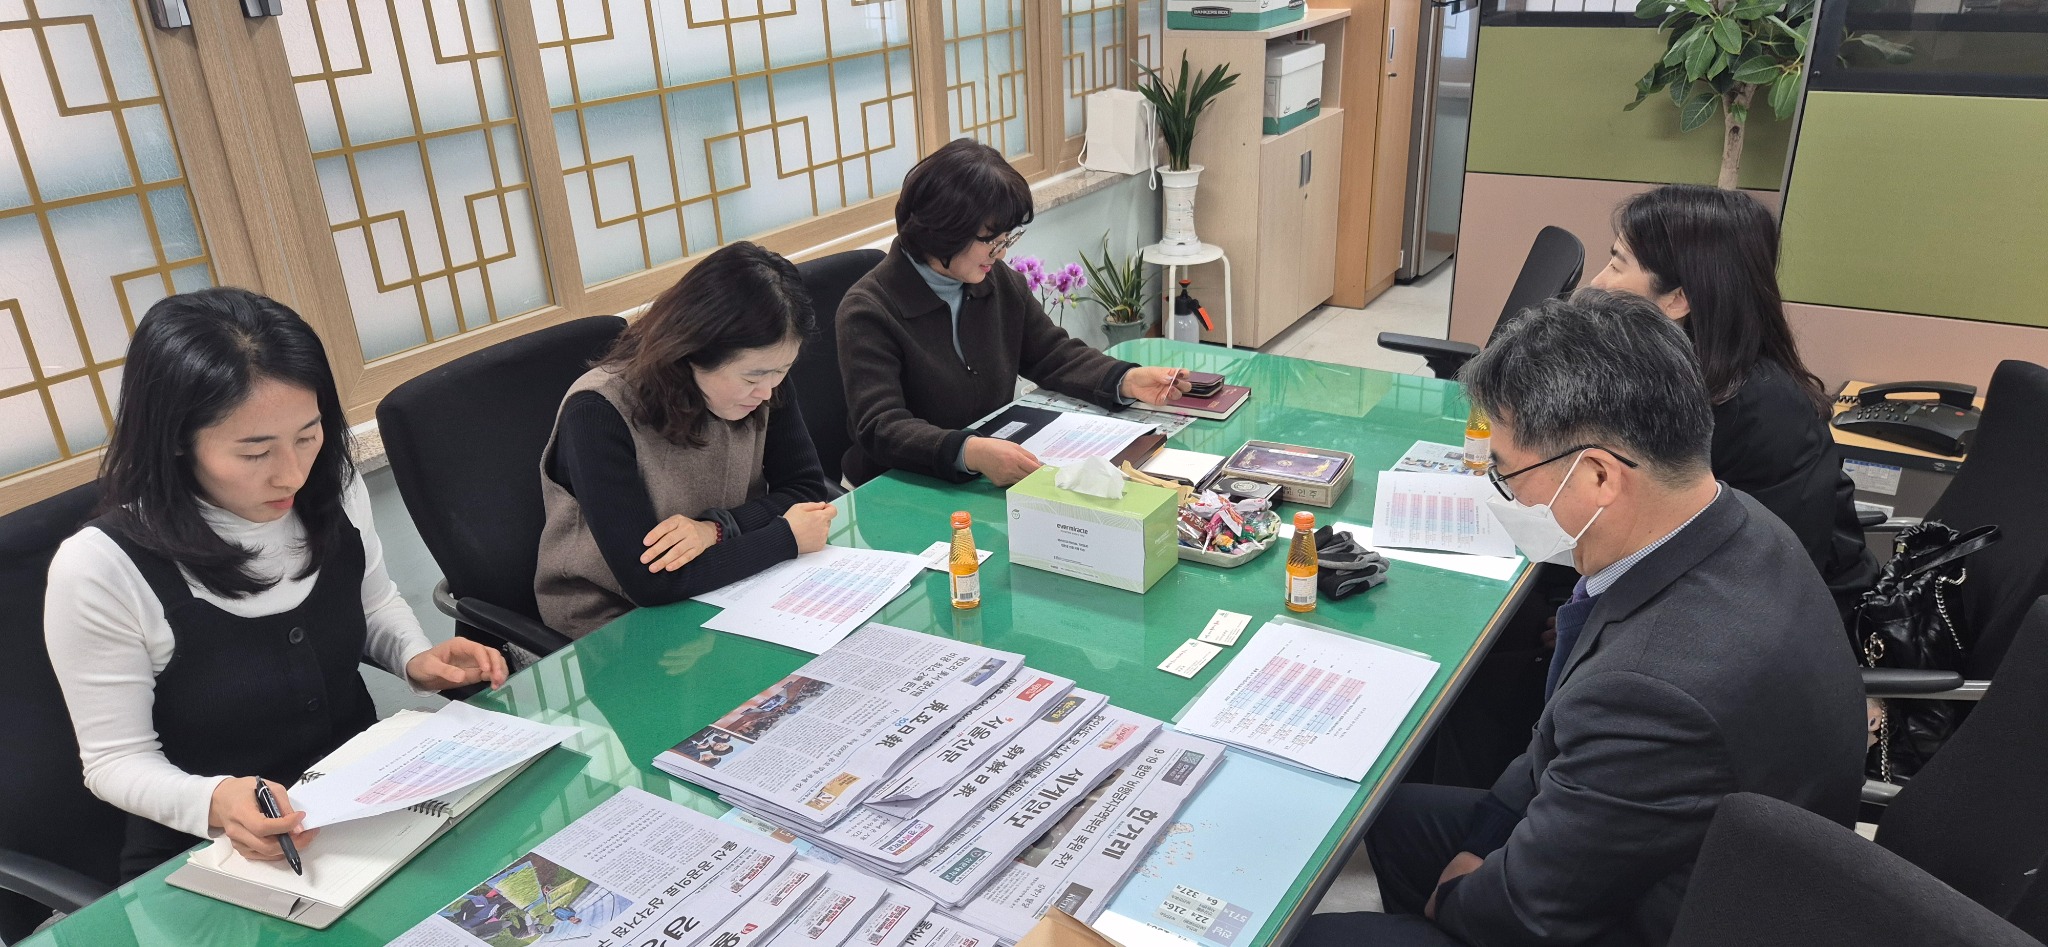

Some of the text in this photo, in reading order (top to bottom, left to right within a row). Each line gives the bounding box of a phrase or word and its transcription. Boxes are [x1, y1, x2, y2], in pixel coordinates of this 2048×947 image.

[875, 700, 949, 748] 東亞日報
[937, 716, 1004, 763] 서울신문
[953, 744, 1025, 797] 朝鮮日報
[1132, 765, 1152, 779] 합의
[1003, 769, 1083, 828] 세계일보
[711, 841, 737, 860] 울산
[1067, 835, 1089, 851] 복원
[1102, 807, 1158, 860] 한겨레
[663, 861, 714, 896] 공공의료
[1051, 852, 1073, 868] 추진
[611, 897, 664, 938] 삼각거점
[1212, 927, 1232, 939] 전남
